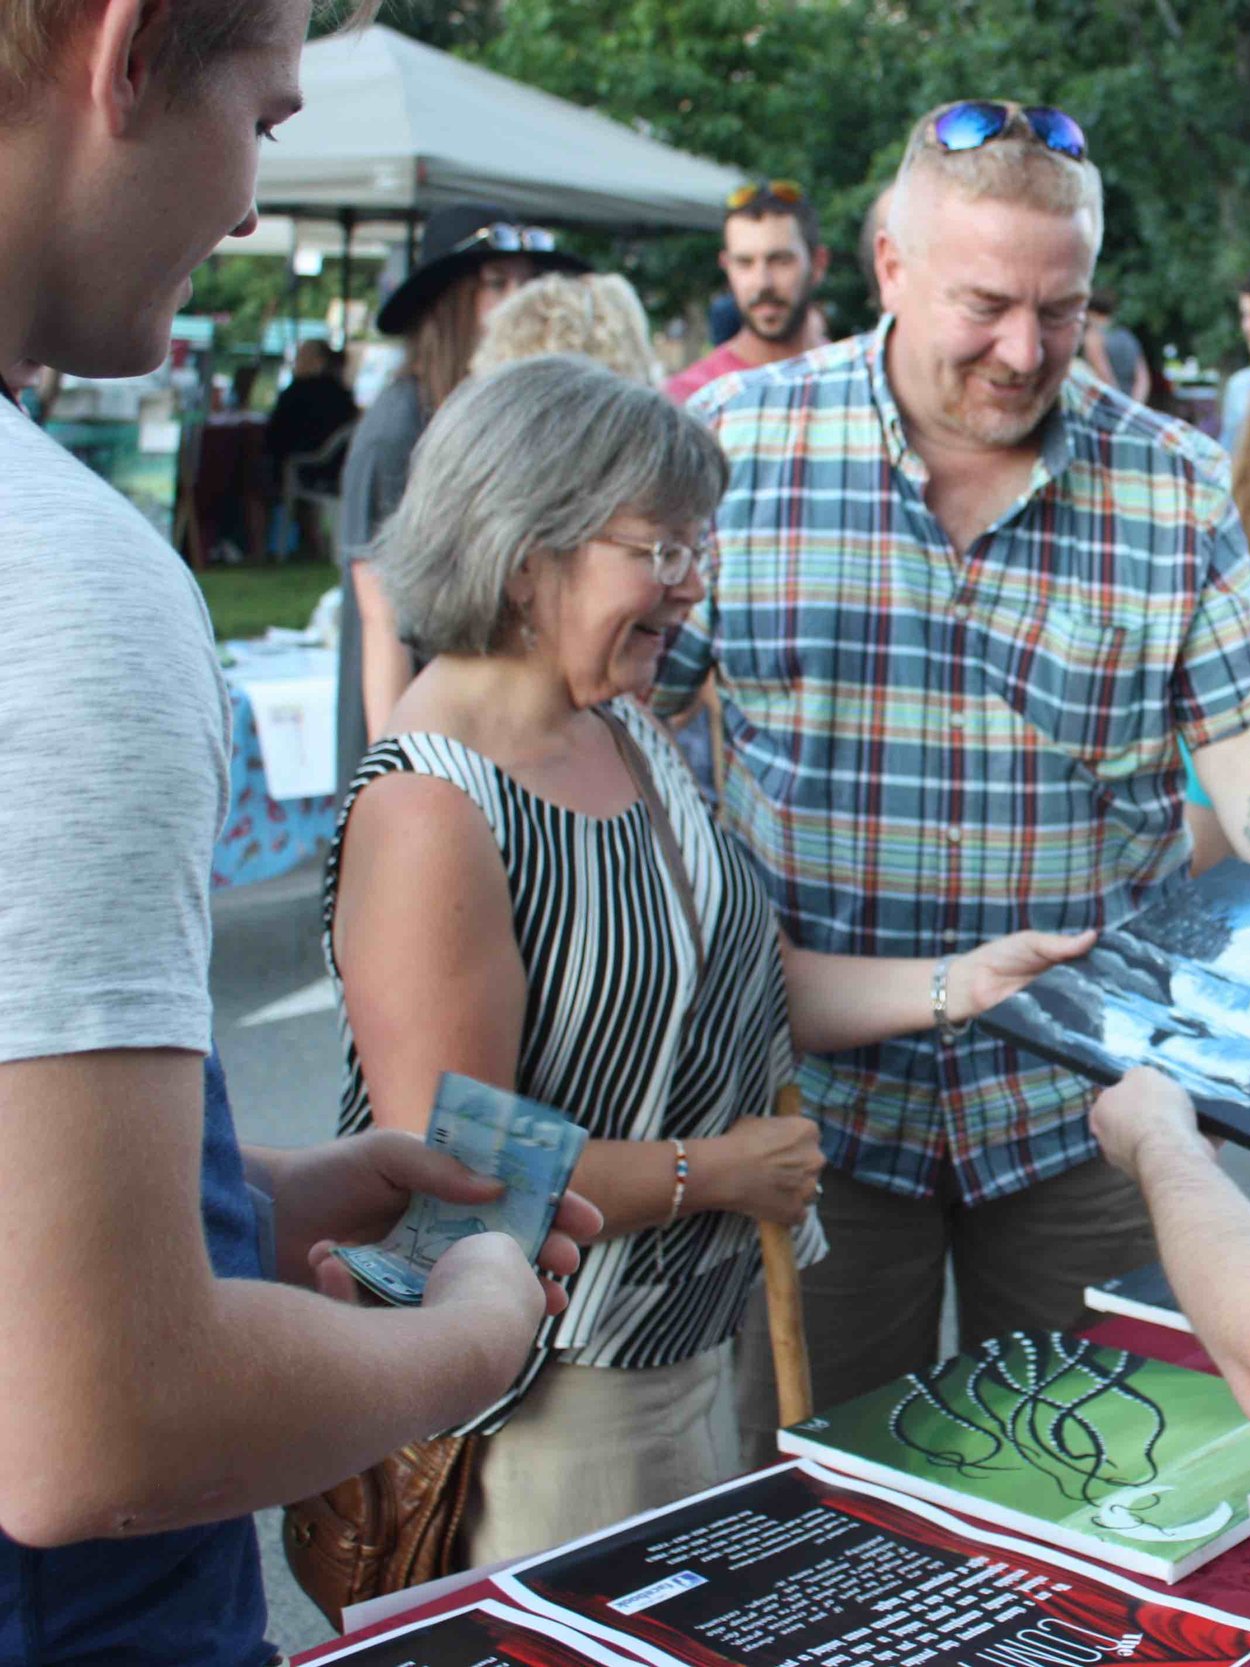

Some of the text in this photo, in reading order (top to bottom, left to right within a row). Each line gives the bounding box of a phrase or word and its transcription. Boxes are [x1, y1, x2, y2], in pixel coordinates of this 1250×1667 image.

[614, 1582, 674, 1608] facebook
[915, 1631, 939, 1642] that
[935, 1639, 960, 1650] that
[956, 1618, 1122, 1667] COM
[1117, 1633, 1143, 1657] The
